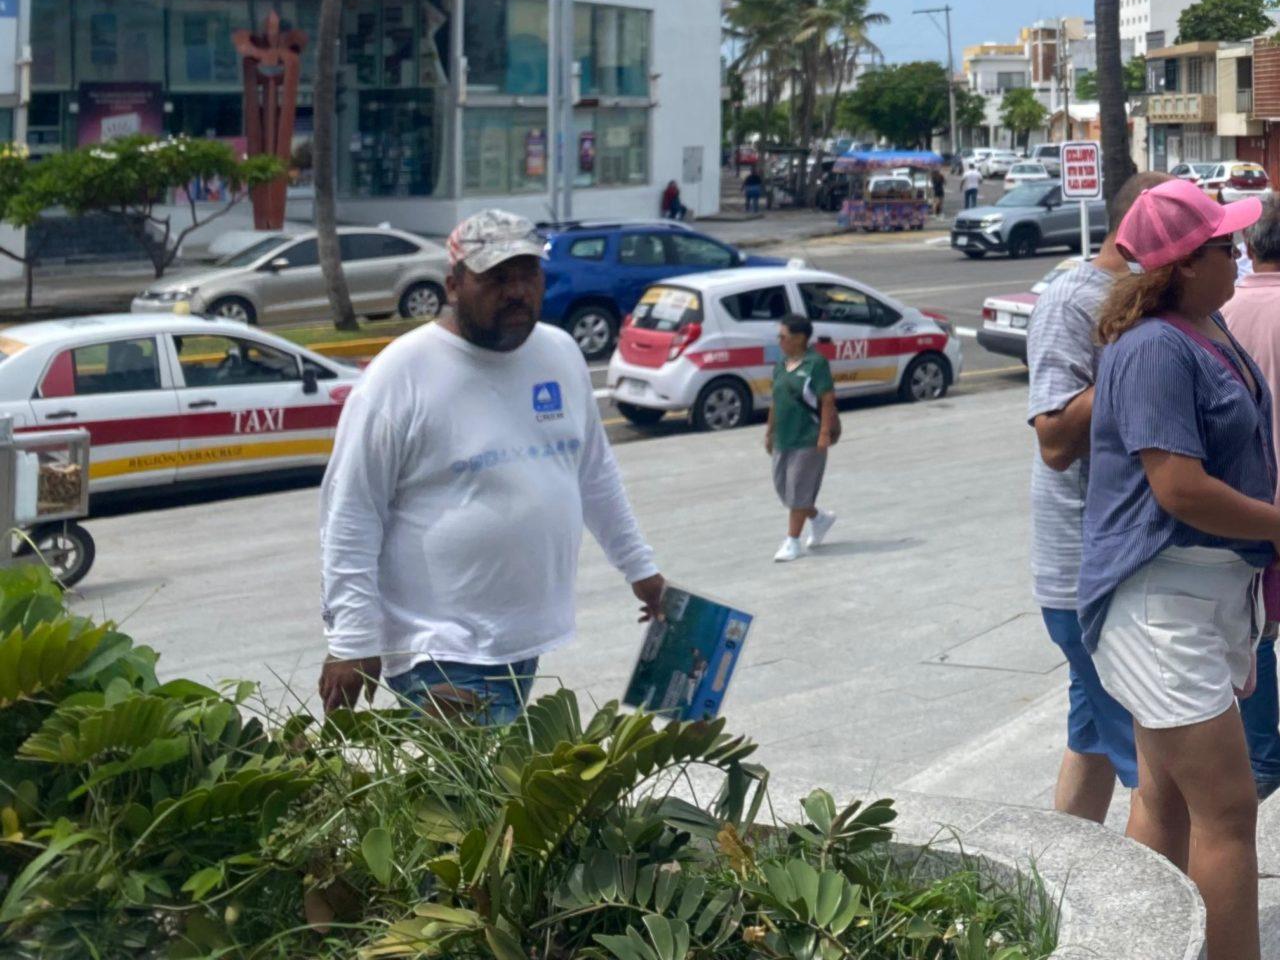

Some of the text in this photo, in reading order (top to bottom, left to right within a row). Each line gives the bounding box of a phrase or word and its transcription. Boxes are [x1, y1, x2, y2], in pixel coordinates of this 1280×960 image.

[834, 339, 868, 360] TAXI
[231, 407, 285, 434] TAXI
[179, 446, 243, 464] VERACRUZ
